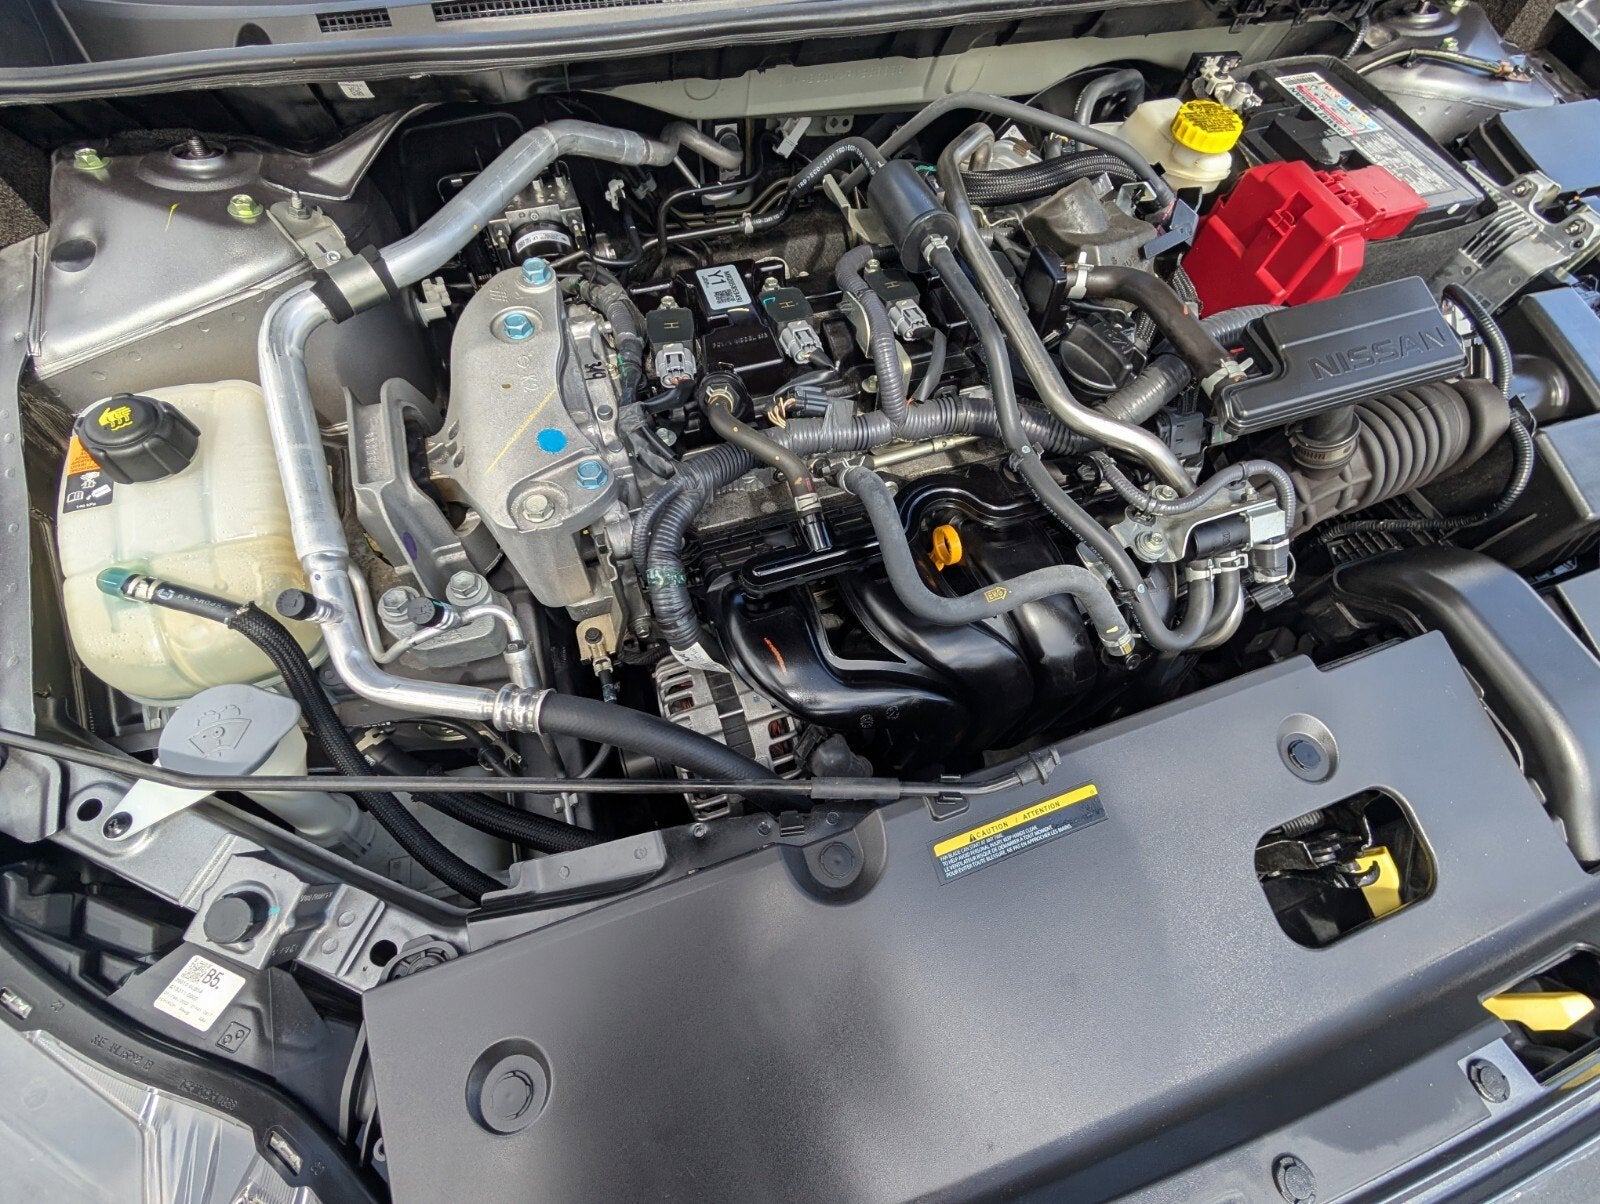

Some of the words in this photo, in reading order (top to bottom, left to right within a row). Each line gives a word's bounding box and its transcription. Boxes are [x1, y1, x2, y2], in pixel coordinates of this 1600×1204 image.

[707, 269, 726, 286] Y1
[1307, 327, 1446, 380] NISSAN
[976, 821, 1009, 839] CAUTION
[1022, 801, 1060, 820] ATTENTION
